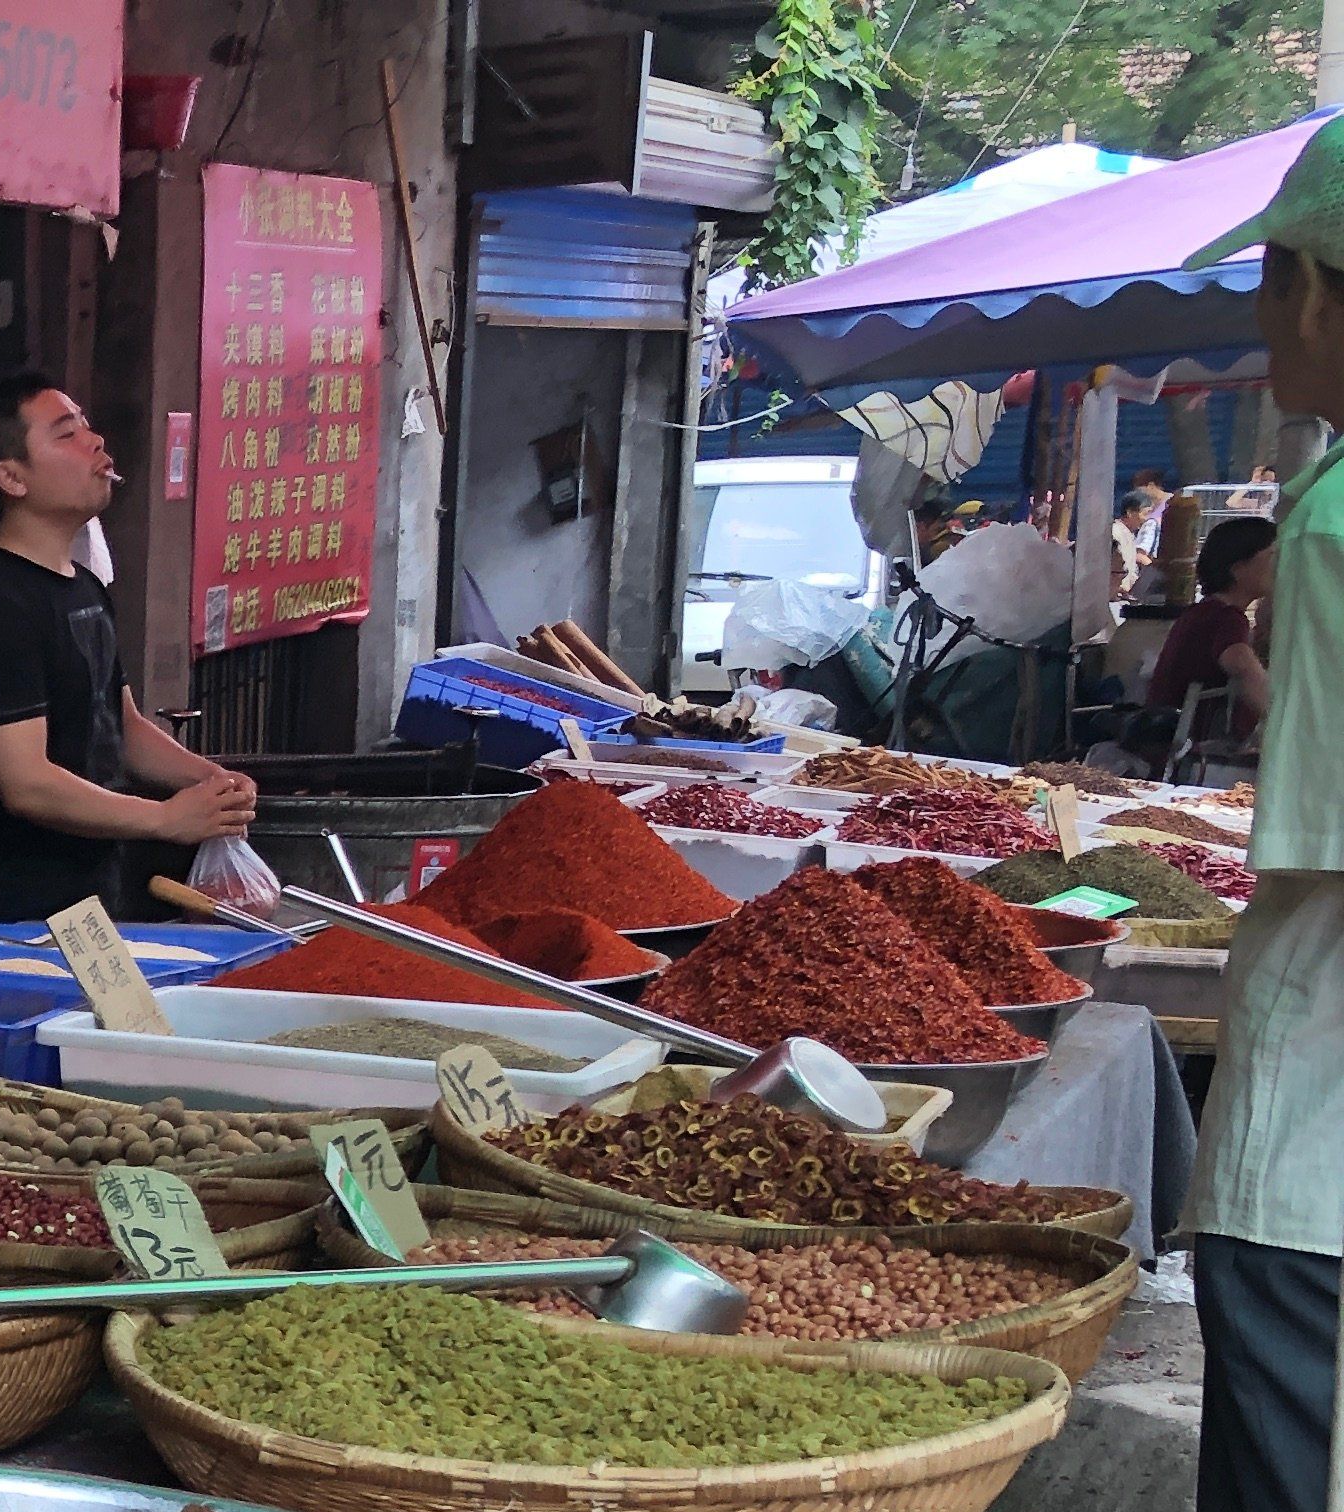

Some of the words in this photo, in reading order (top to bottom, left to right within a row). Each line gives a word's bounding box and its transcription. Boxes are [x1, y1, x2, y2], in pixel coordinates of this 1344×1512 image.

[225, 270, 284, 314] 十三香
[219, 426, 280, 469] 八角粉
[100, 1172, 189, 1233] 葡萄干
